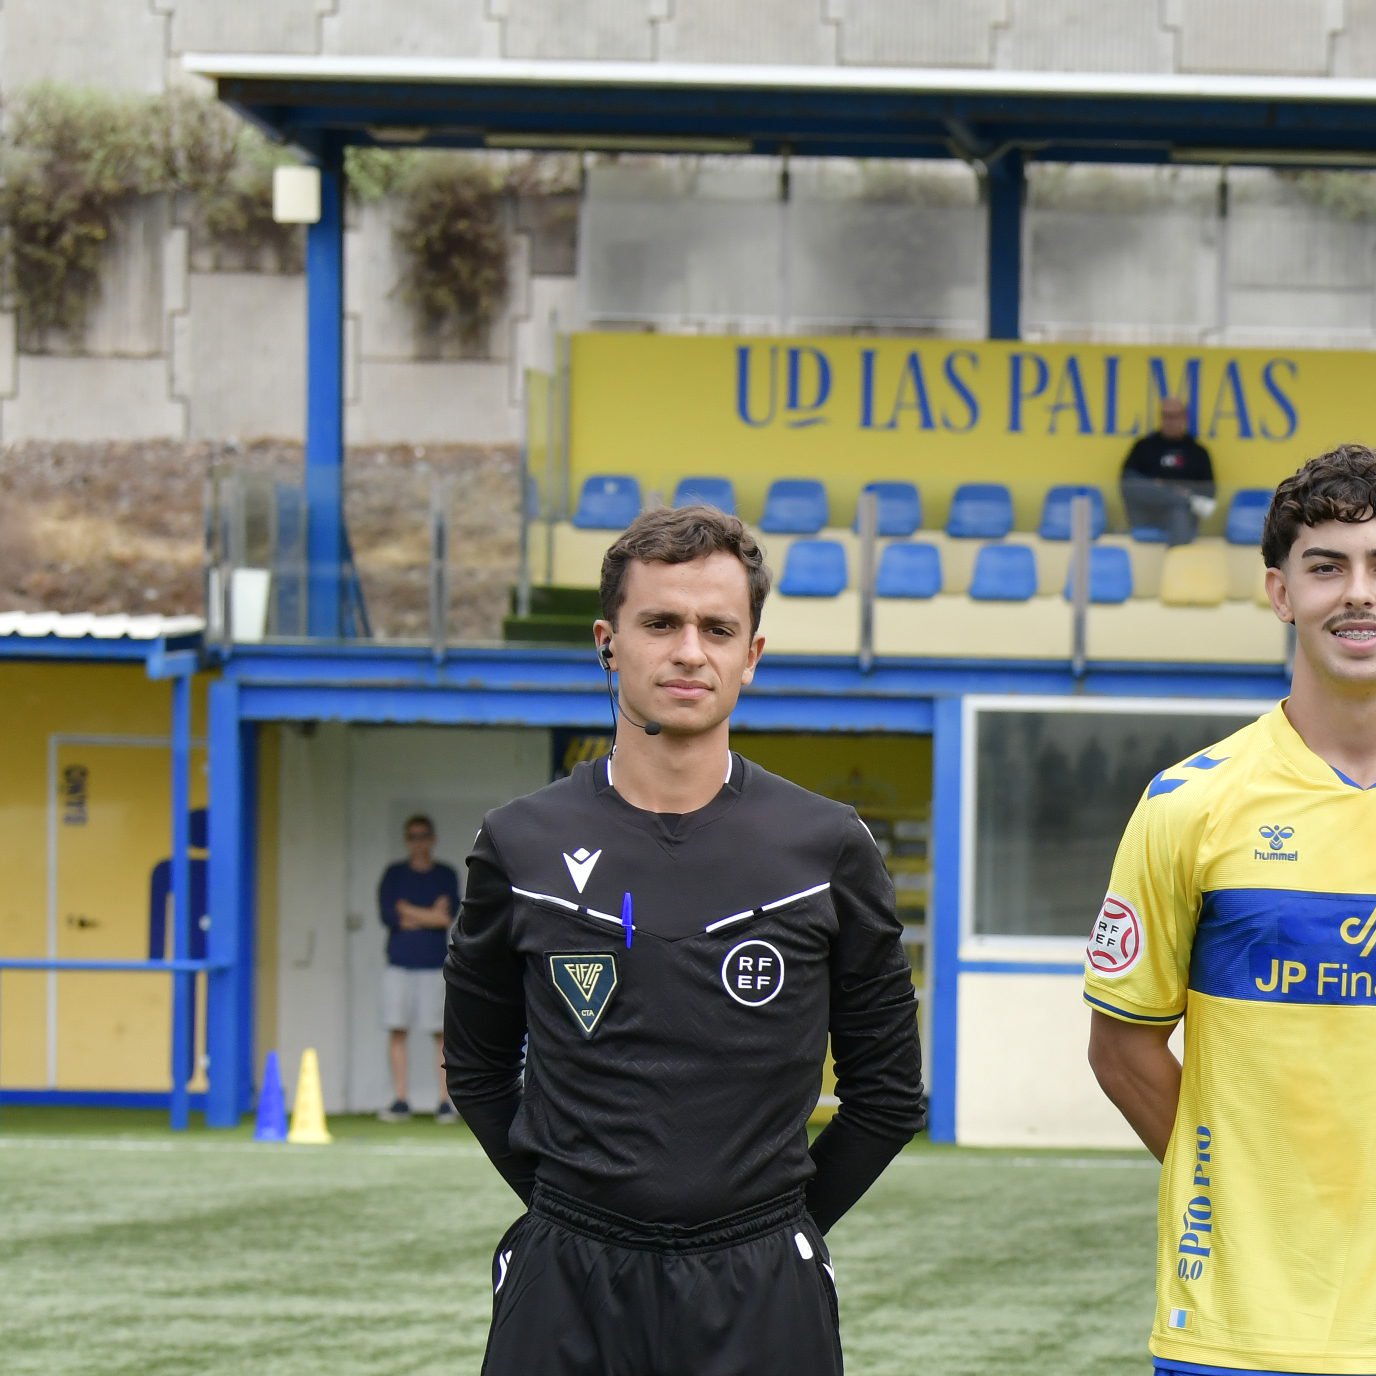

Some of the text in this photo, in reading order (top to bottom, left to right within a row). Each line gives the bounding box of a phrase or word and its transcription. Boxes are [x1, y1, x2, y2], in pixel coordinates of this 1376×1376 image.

[735, 345, 1300, 440] UD LAS PALMAS
[1254, 849, 1298, 862] hummel
[1255, 958, 1307, 995] JP
